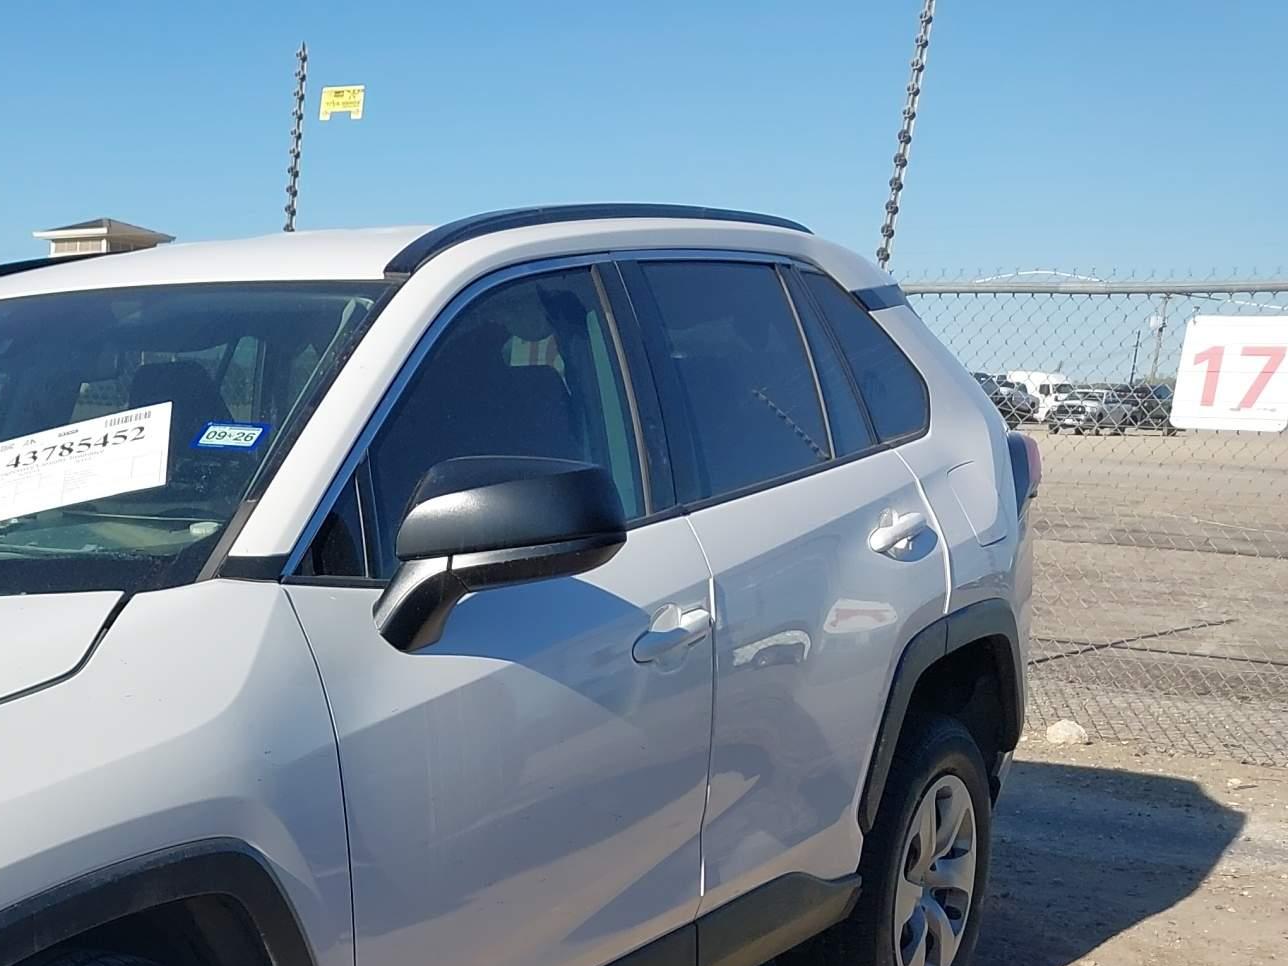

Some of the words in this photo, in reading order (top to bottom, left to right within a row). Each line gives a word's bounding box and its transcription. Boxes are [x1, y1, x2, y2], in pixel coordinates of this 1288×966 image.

[1193, 346, 1288, 409] 17
[5, 426, 146, 469] 43785452
[205, 430, 228, 441] 09
[232, 431, 256, 442] 26
